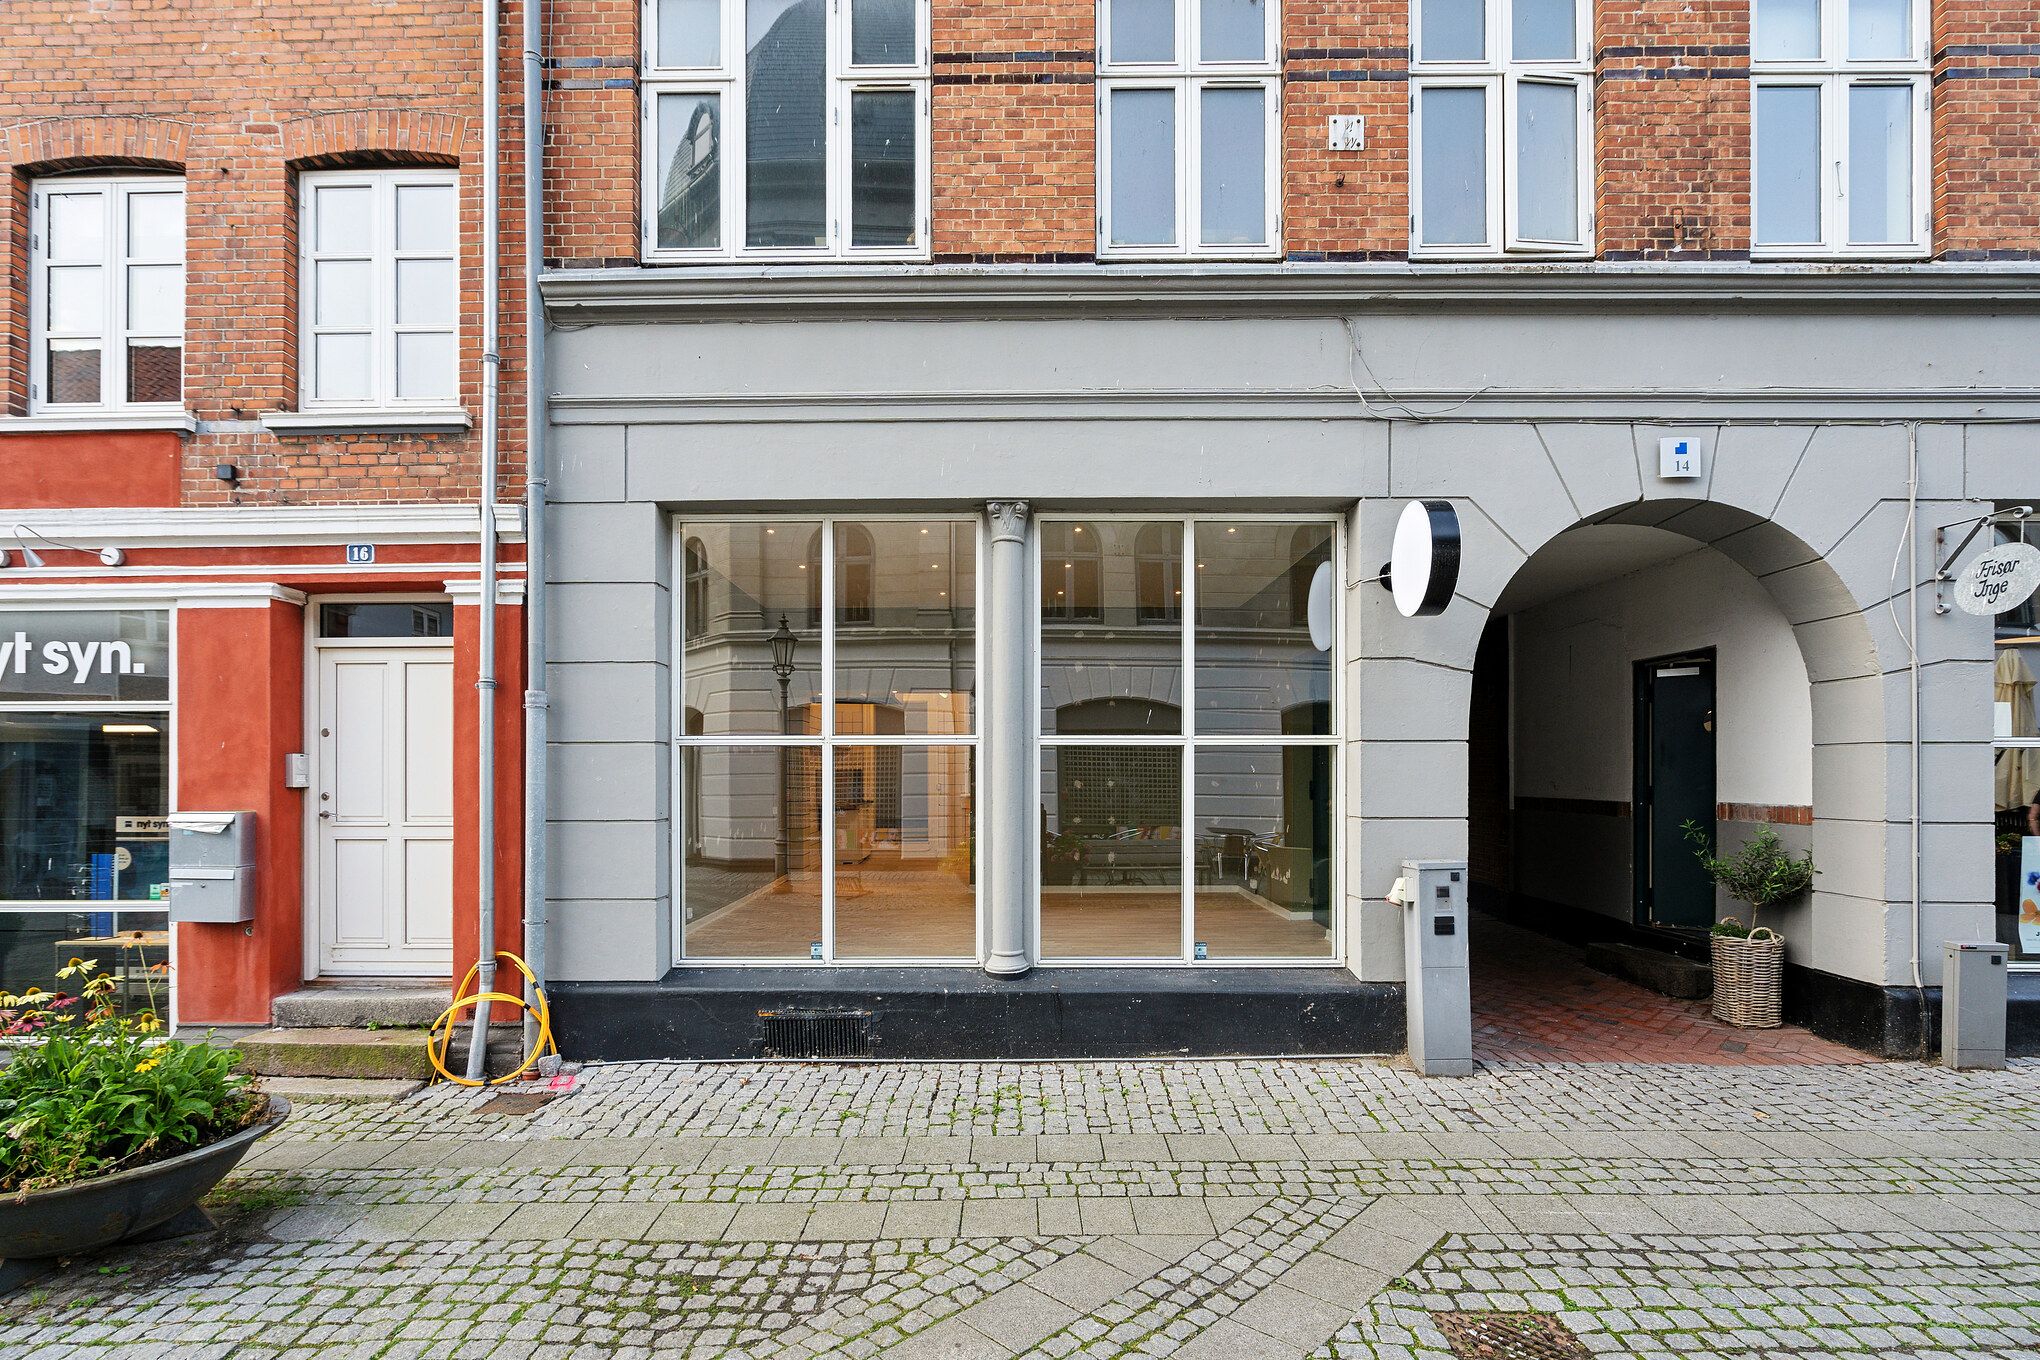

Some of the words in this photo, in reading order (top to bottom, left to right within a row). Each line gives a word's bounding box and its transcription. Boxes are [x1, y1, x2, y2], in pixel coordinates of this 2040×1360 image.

[1676, 460, 1689, 472] 14
[353, 546, 369, 561] 16
[1975, 559, 2020, 579] Frisør
[42, 640, 145, 684] syn.
[137, 819, 152, 830] nyt
